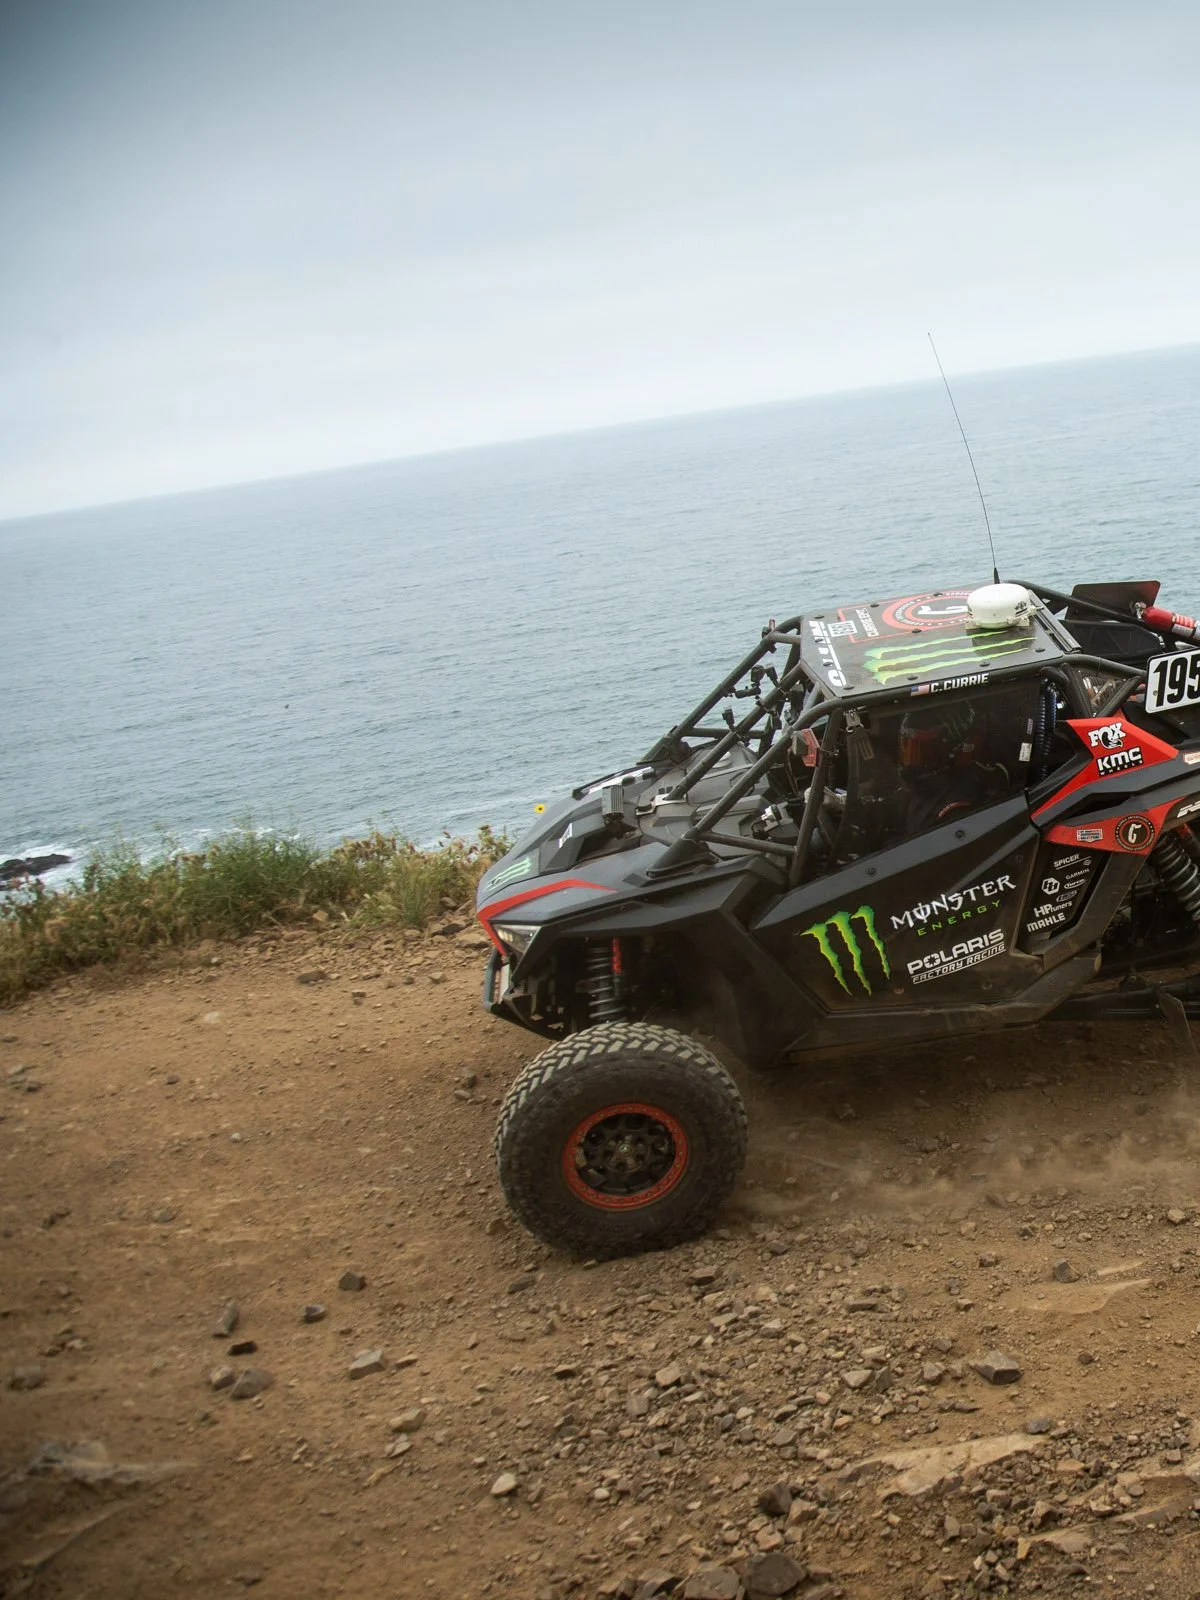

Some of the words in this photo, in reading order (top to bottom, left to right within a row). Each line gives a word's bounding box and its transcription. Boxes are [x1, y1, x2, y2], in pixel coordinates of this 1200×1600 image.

[808, 620, 847, 687] NITTO
[1088, 721, 1126, 749] FOX
[1097, 747, 1142, 772] KMC
[1099, 759, 1143, 776] WHEELS
[1053, 853, 1080, 868] SPICER
[1065, 868, 1090, 880] GARMIN
[890, 874, 1017, 930] MONSTER
[917, 900, 1000, 937] ENERGY
[1026, 912, 1066, 932] MAHLE
[906, 928, 1004, 975] POLARIS
[912, 961, 964, 984] FACTORY
[966, 943, 1006, 966] RACING
